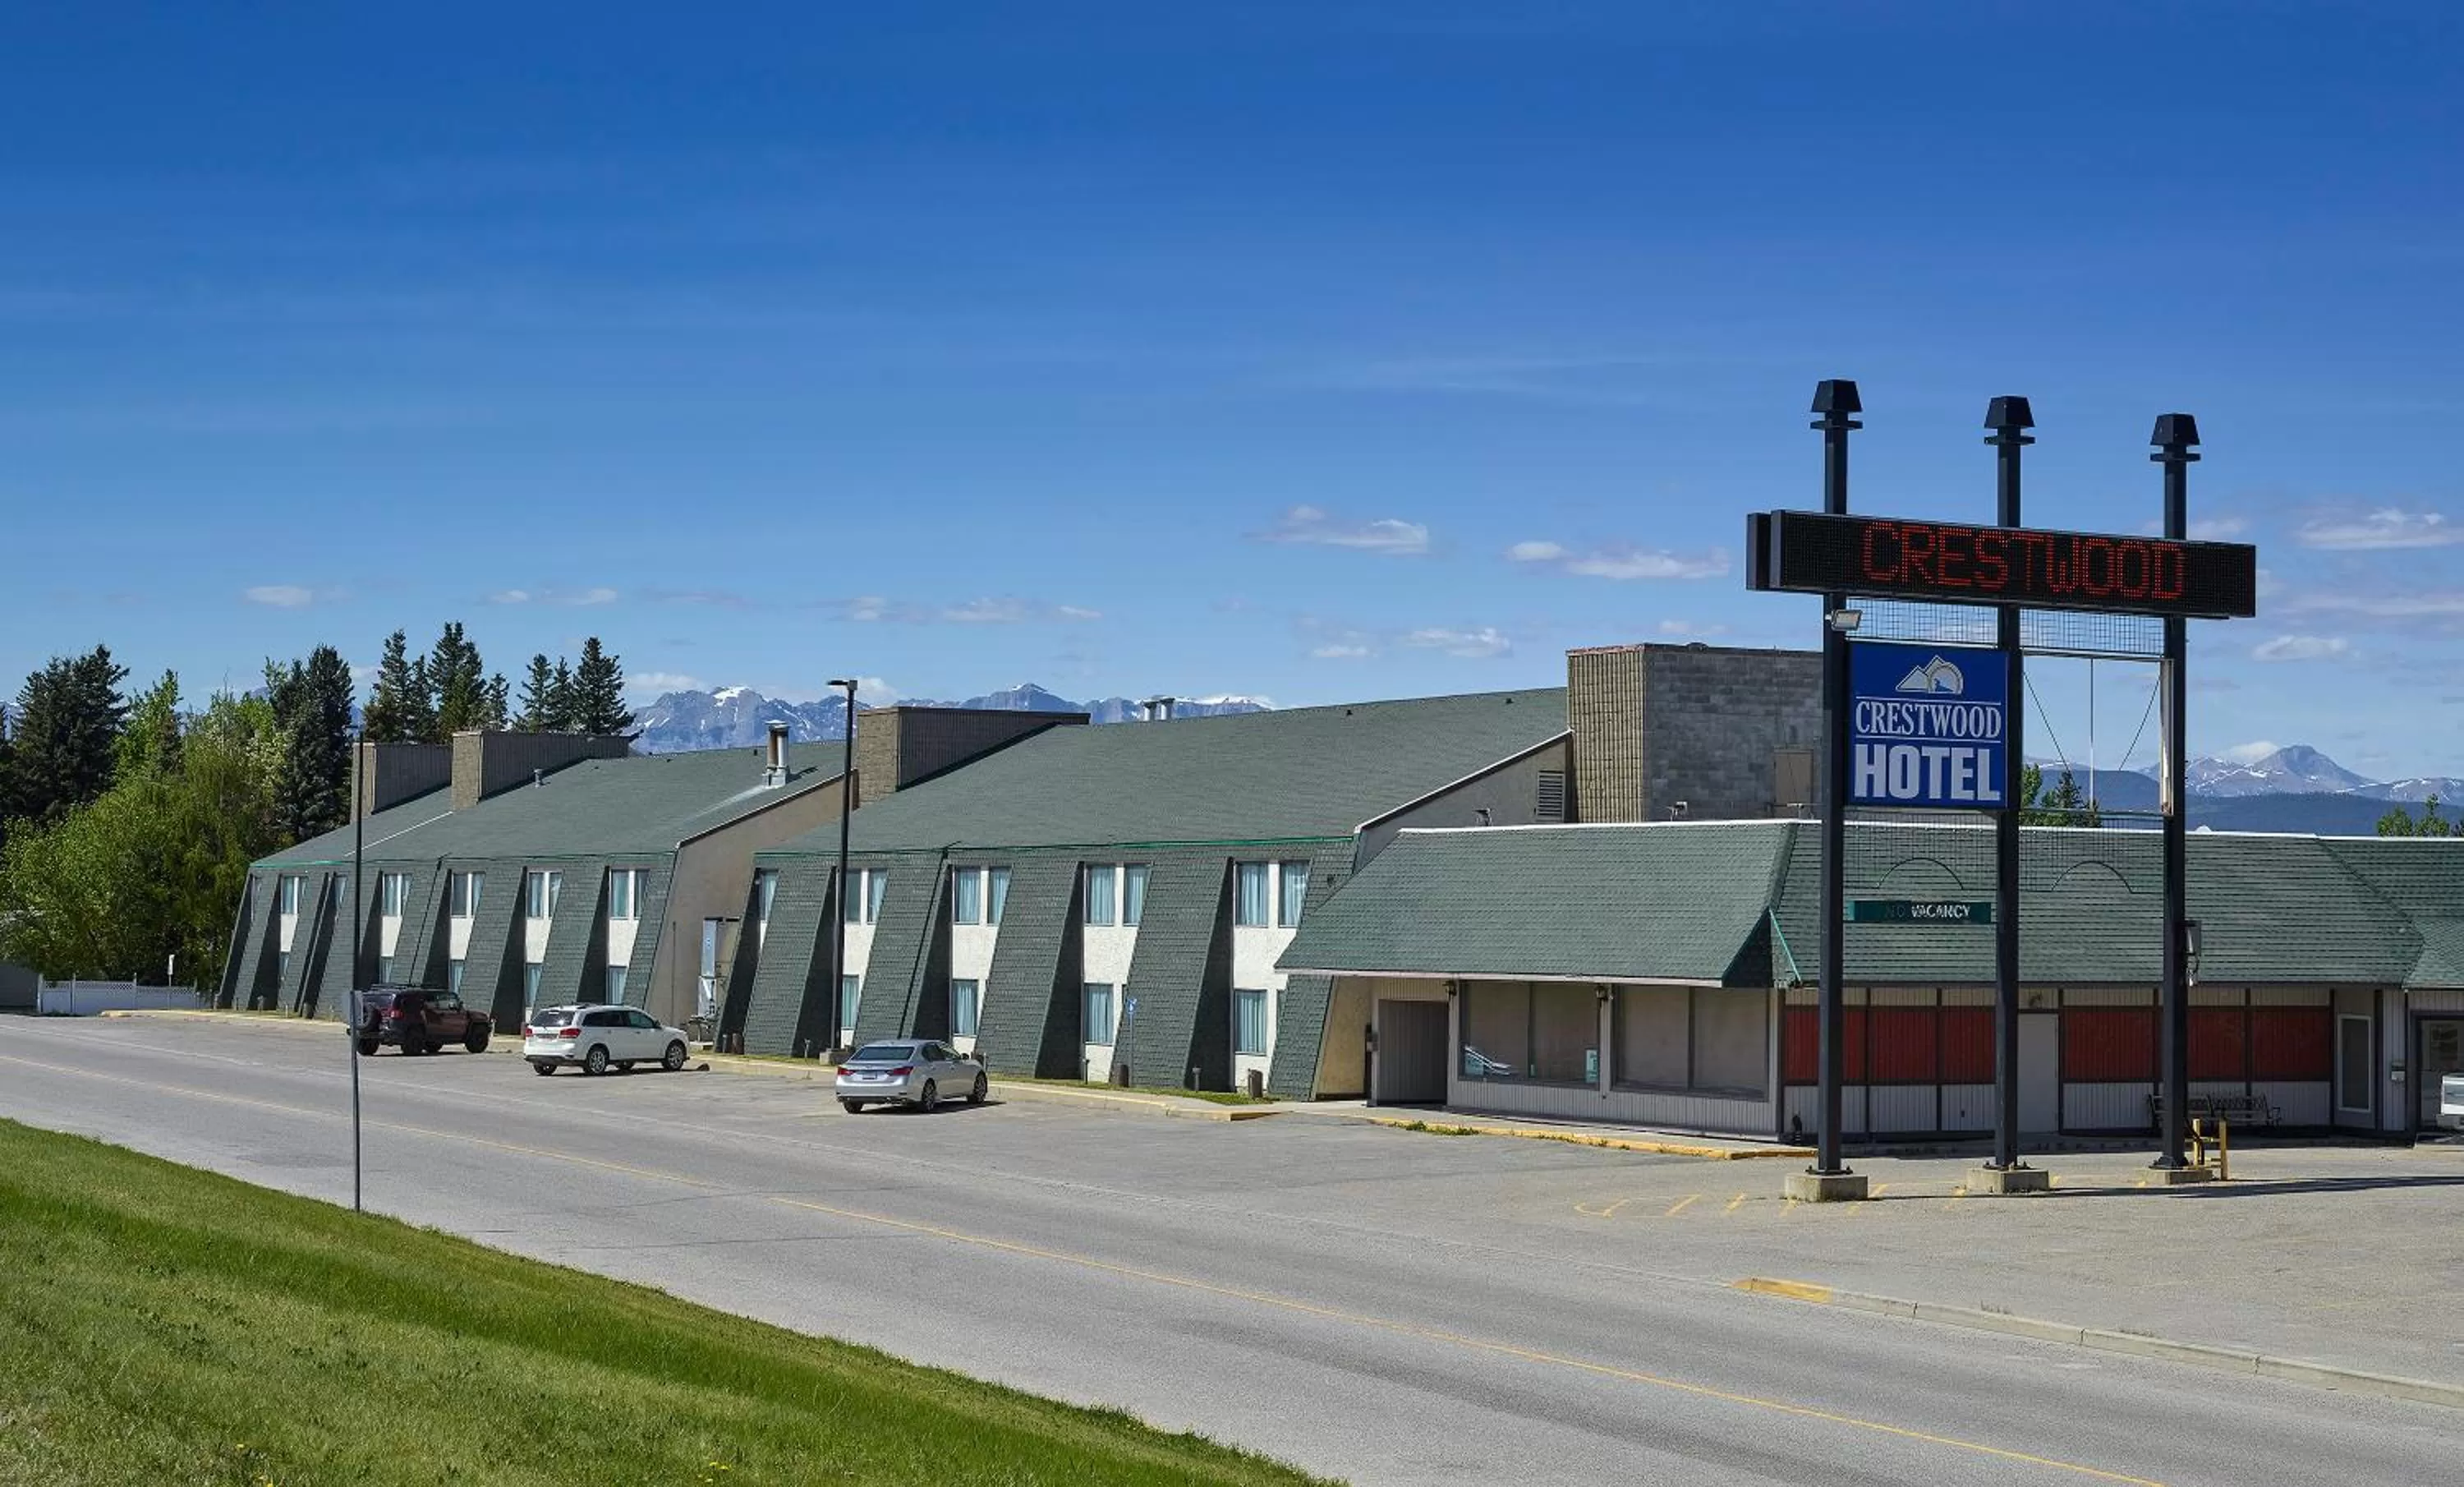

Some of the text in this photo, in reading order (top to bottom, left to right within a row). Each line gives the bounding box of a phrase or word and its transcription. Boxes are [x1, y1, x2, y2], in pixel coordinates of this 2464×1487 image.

[1863, 522, 2185, 600] CRESTWOOD
[1855, 701, 2002, 739] CRESTWOOD
[1854, 744, 2001, 801] HOTEL
[1911, 905, 1970, 918] VACANCY
